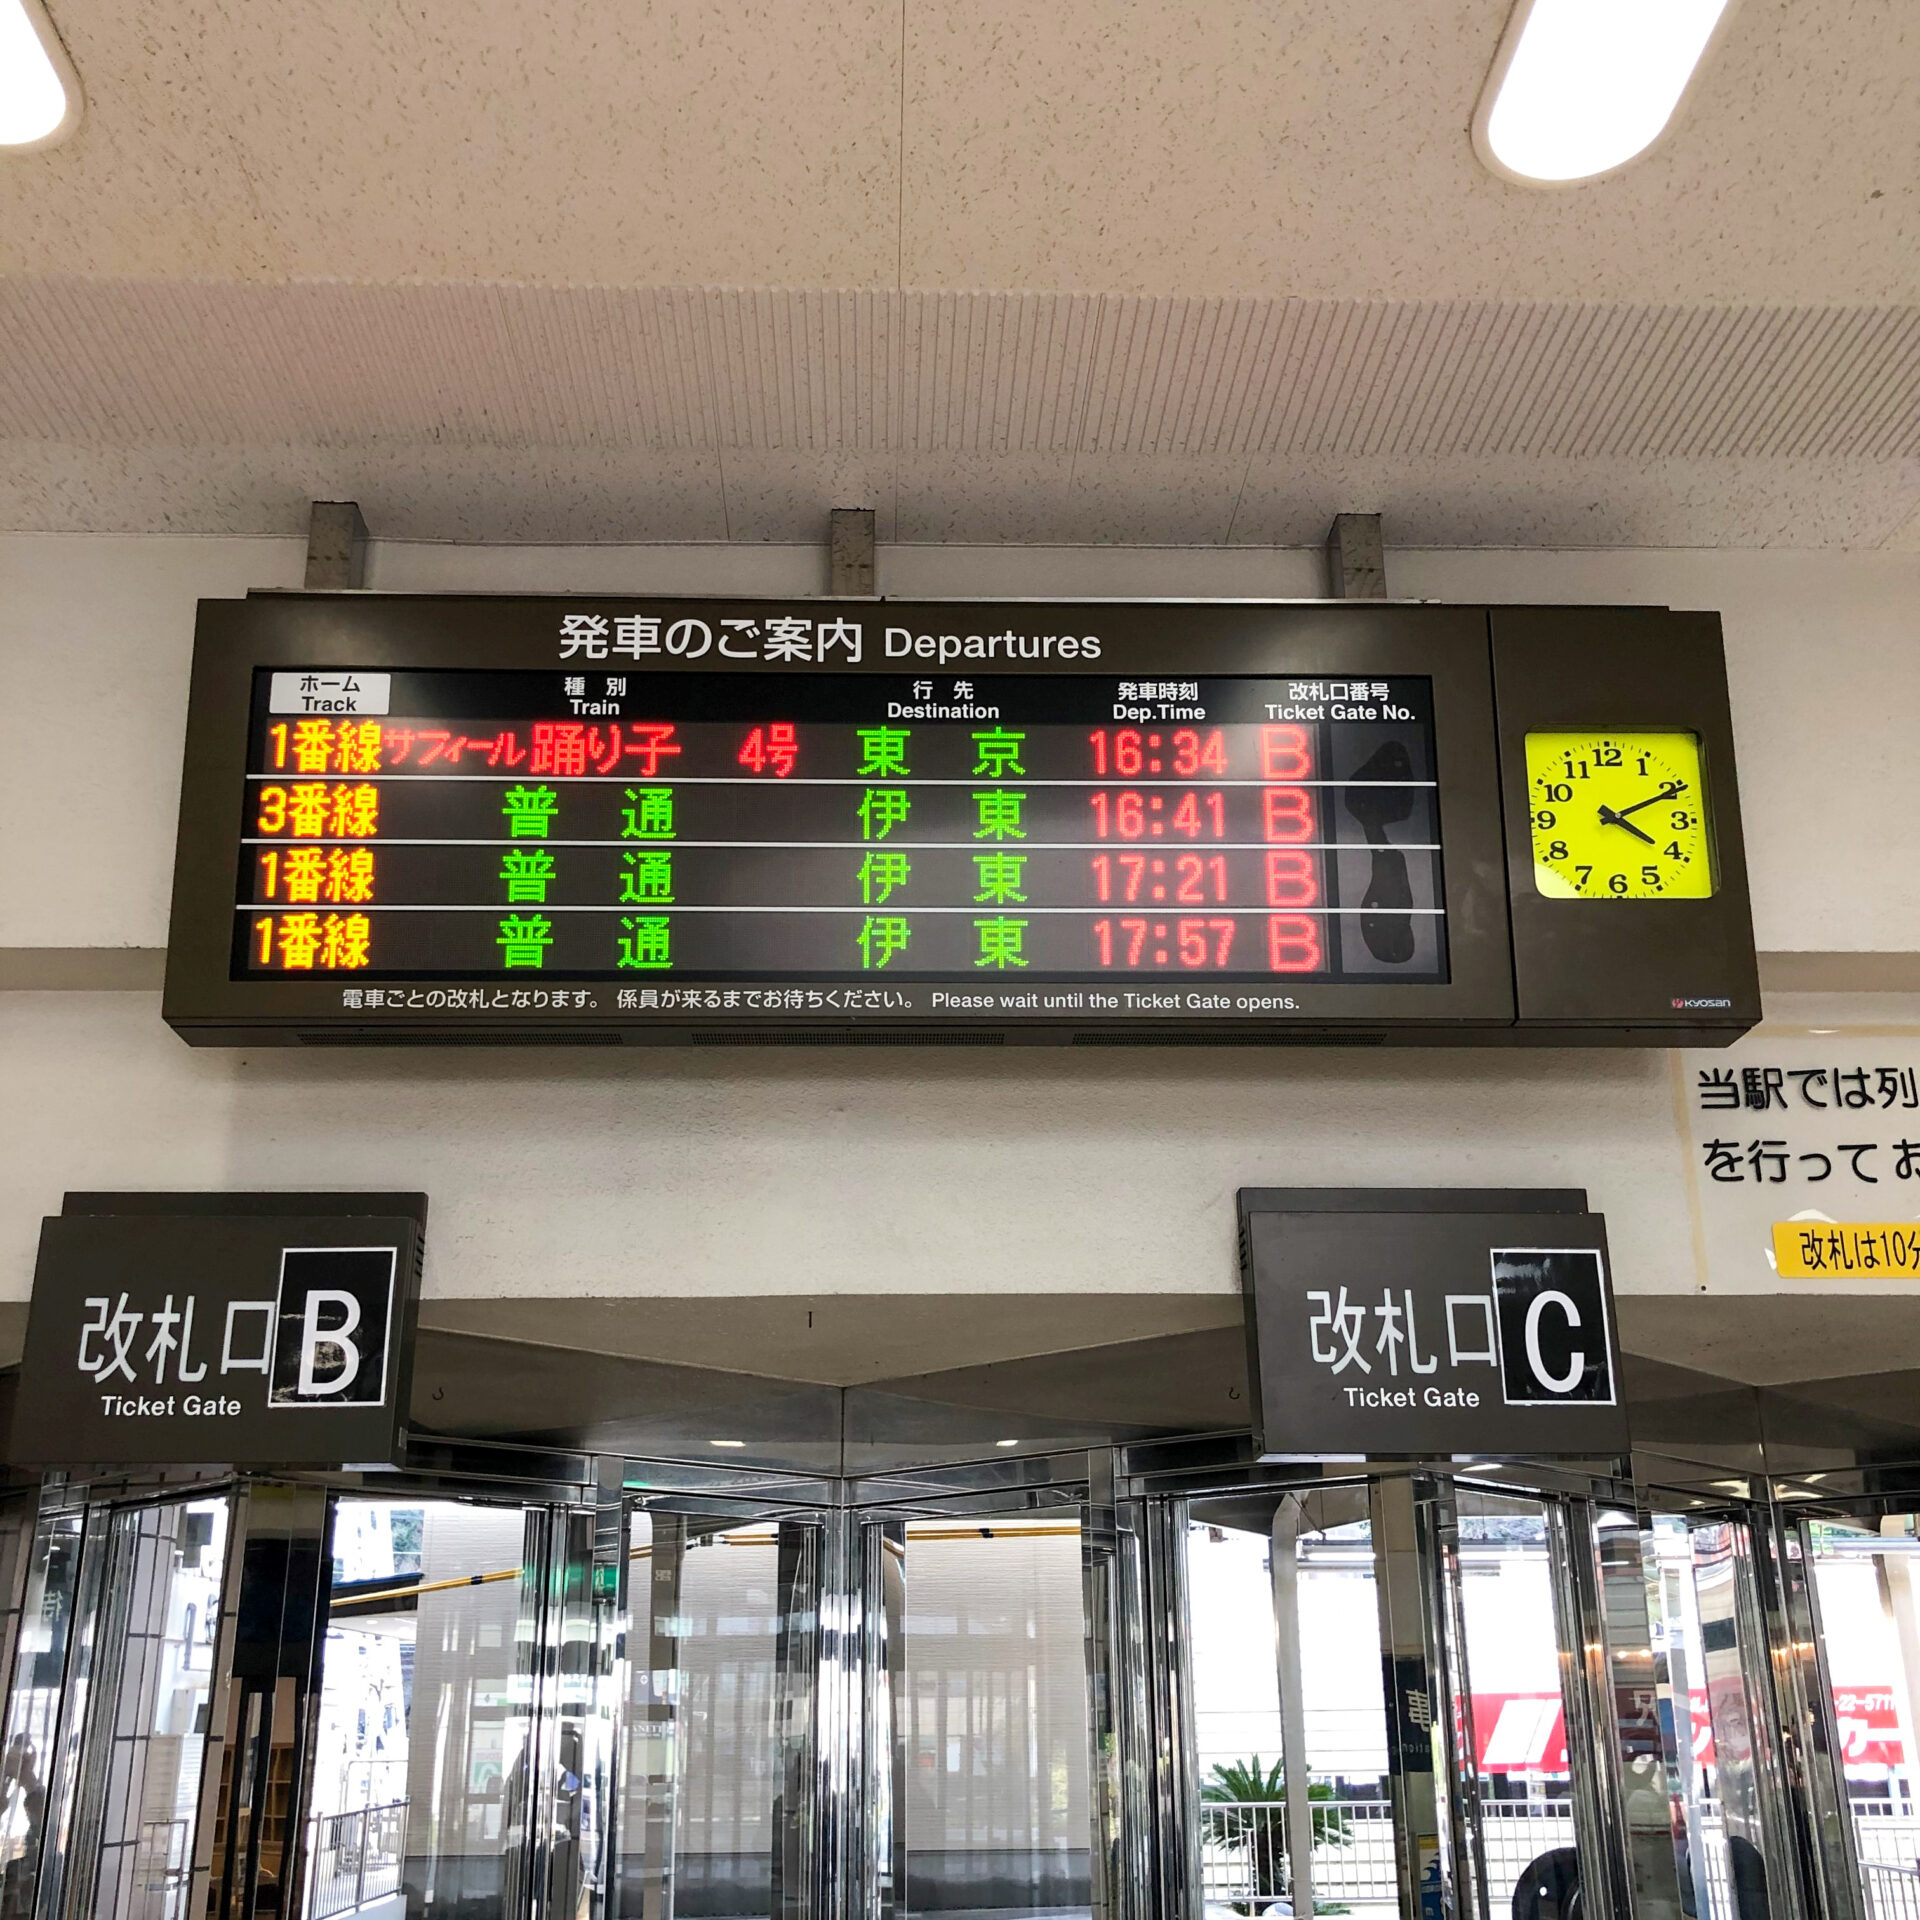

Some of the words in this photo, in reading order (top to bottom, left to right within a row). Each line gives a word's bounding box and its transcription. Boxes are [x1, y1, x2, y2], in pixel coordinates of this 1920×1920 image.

[559, 615, 861, 662] 発車のご案内
[885, 628, 1101, 663] Departures
[299, 675, 361, 693] ホーム
[1118, 682, 1198, 701] 発車時刻
[1288, 682, 1390, 702] 改札口番号
[301, 696, 356, 711] Track
[570, 699, 620, 715] Train
[887, 702, 1000, 720] Destination
[1113, 703, 1206, 722] Dep.Time
[1265, 703, 1325, 720] Ticket
[1330, 703, 1378, 720] Gate
[1382, 704, 1416, 721] No.
[271, 719, 382, 773] 1番線
[738, 723, 798, 777] 4号
[1089, 730, 1228, 775] 16:34
[1259, 726, 1311, 780] B
[1592, 748, 1623, 767] 12
[1564, 761, 1590, 779] 11
[1636, 758, 1648, 776] 1
[1544, 784, 1573, 802] 10
[1659, 782, 1678, 800] 2
[257, 783, 379, 837] 3番線
[1090, 792, 1226, 838] 16:41
[1262, 788, 1314, 843] B
[1536, 810, 1556, 829] 9
[1670, 811, 1689, 830] 3
[1549, 841, 1568, 859] 8
[1664, 841, 1683, 859] 4
[261, 848, 374, 902] 1番線
[1092, 855, 1227, 900] 17:21
[1265, 850, 1318, 907] B
[1575, 865, 1592, 884] 7
[1608, 874, 1628, 893] 6
[1641, 866, 1660, 885] 5
[256, 913, 370, 969] 1番線
[1093, 920, 1236, 966] 17:57
[1268, 914, 1320, 973] B
[342, 989, 598, 1009] 電車ごとの改札となります。
[617, 989, 912, 1009] 係員が来るまでお待ちください。
[931, 993, 994, 1008] Please
[1000, 993, 1037, 1008] wait
[1044, 993, 1083, 1008] until
[1089, 994, 1118, 1009] the
[1123, 994, 1180, 1009] Ticket
[1186, 994, 1230, 1009] Gate
[1236, 996, 1300, 1013] opens.
[1698, 1066, 1919, 1110] 当駅では列
[78, 1292, 277, 1384] 改札口
[297, 1290, 361, 1395] B
[1307, 1286, 1498, 1376] 改札口
[1524, 1290, 1585, 1393] C
[101, 1396, 175, 1416] Ticket
[182, 1396, 241, 1416] Gate
[1344, 1387, 1416, 1408] Ticket
[1424, 1387, 1480, 1408] Gate
